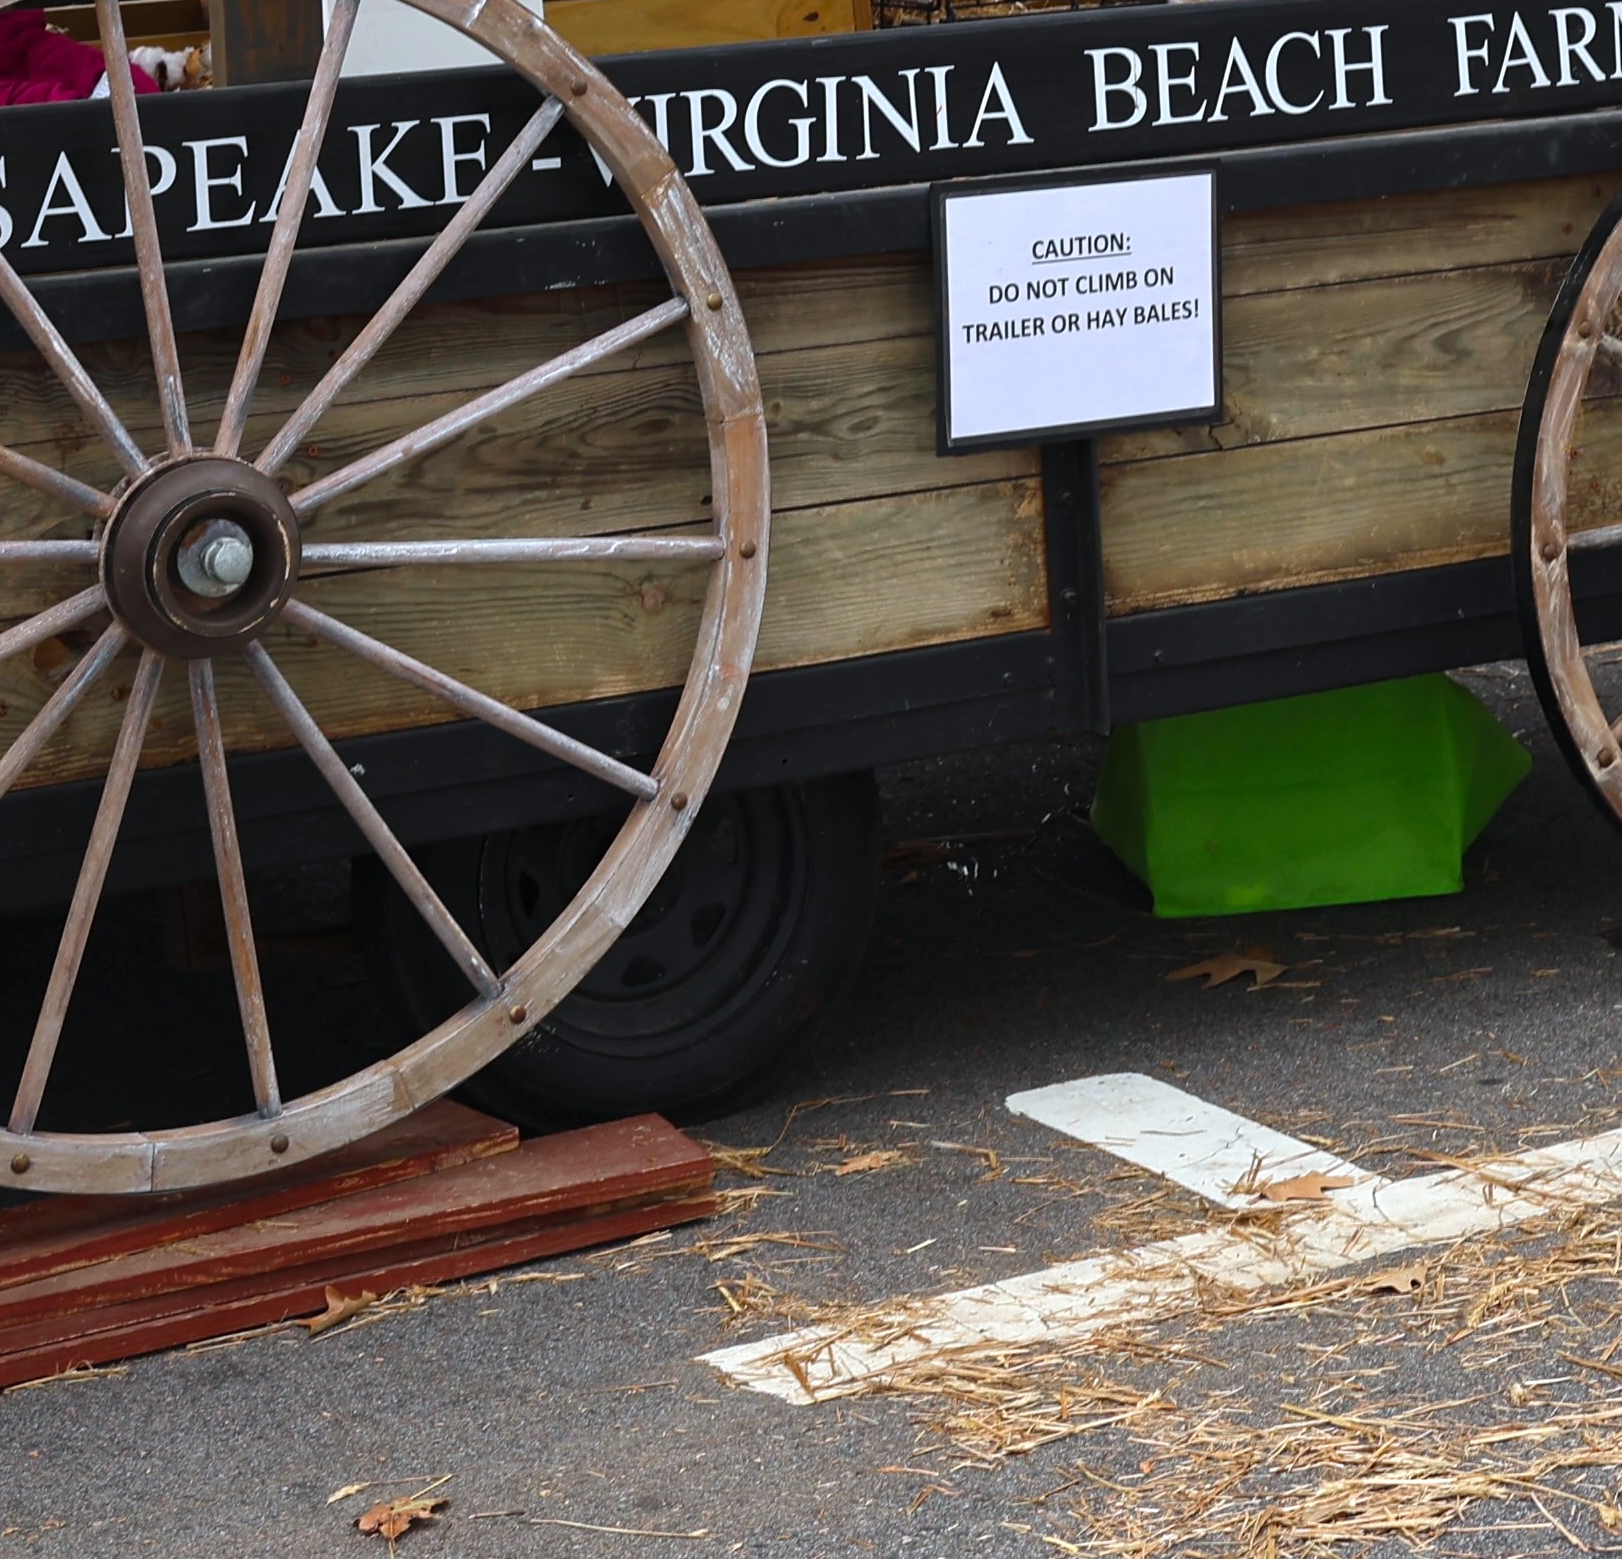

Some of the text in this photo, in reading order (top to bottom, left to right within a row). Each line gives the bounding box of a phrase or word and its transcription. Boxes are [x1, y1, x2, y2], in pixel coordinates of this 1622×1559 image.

[1084, 24, 1393, 132] BEACH
[1031, 232, 1132, 262] CAUTION:
[989, 266, 1174, 304] DO NOT CLIMB ON
[962, 298, 1199, 344] TRAILER OR HAY BALES!
